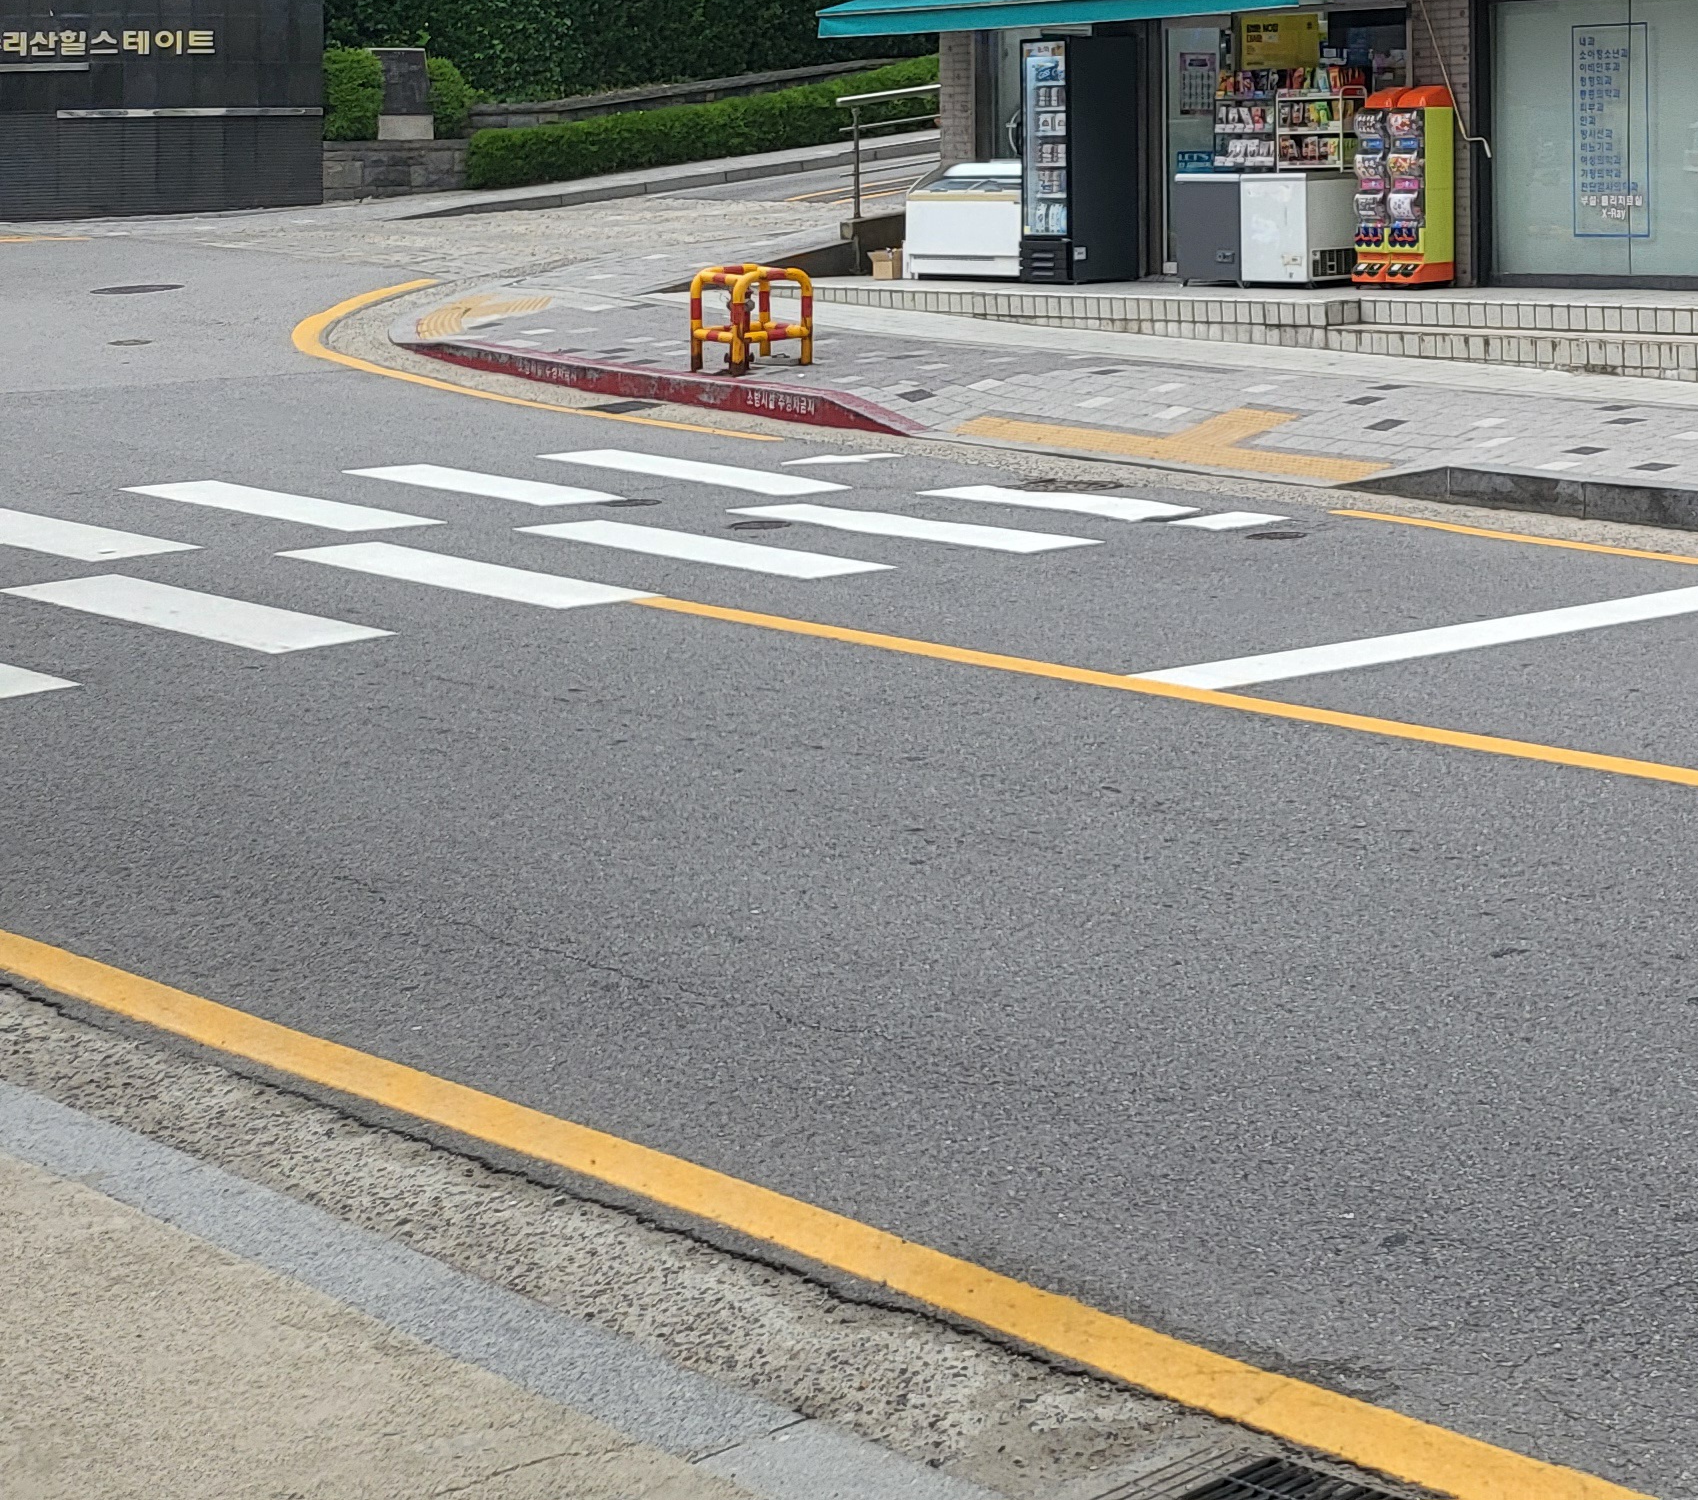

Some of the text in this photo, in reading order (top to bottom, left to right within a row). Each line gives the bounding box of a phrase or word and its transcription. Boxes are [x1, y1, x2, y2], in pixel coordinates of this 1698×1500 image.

[0, 29, 216, 57] 리산힐스테이트
[1579, 36, 1595, 46] 내과
[1580, 102, 1604, 114] 피부과
[1601, 208, 1627, 220] X-Ray
[746, 388, 815, 416] 소방시설 주정차금지
